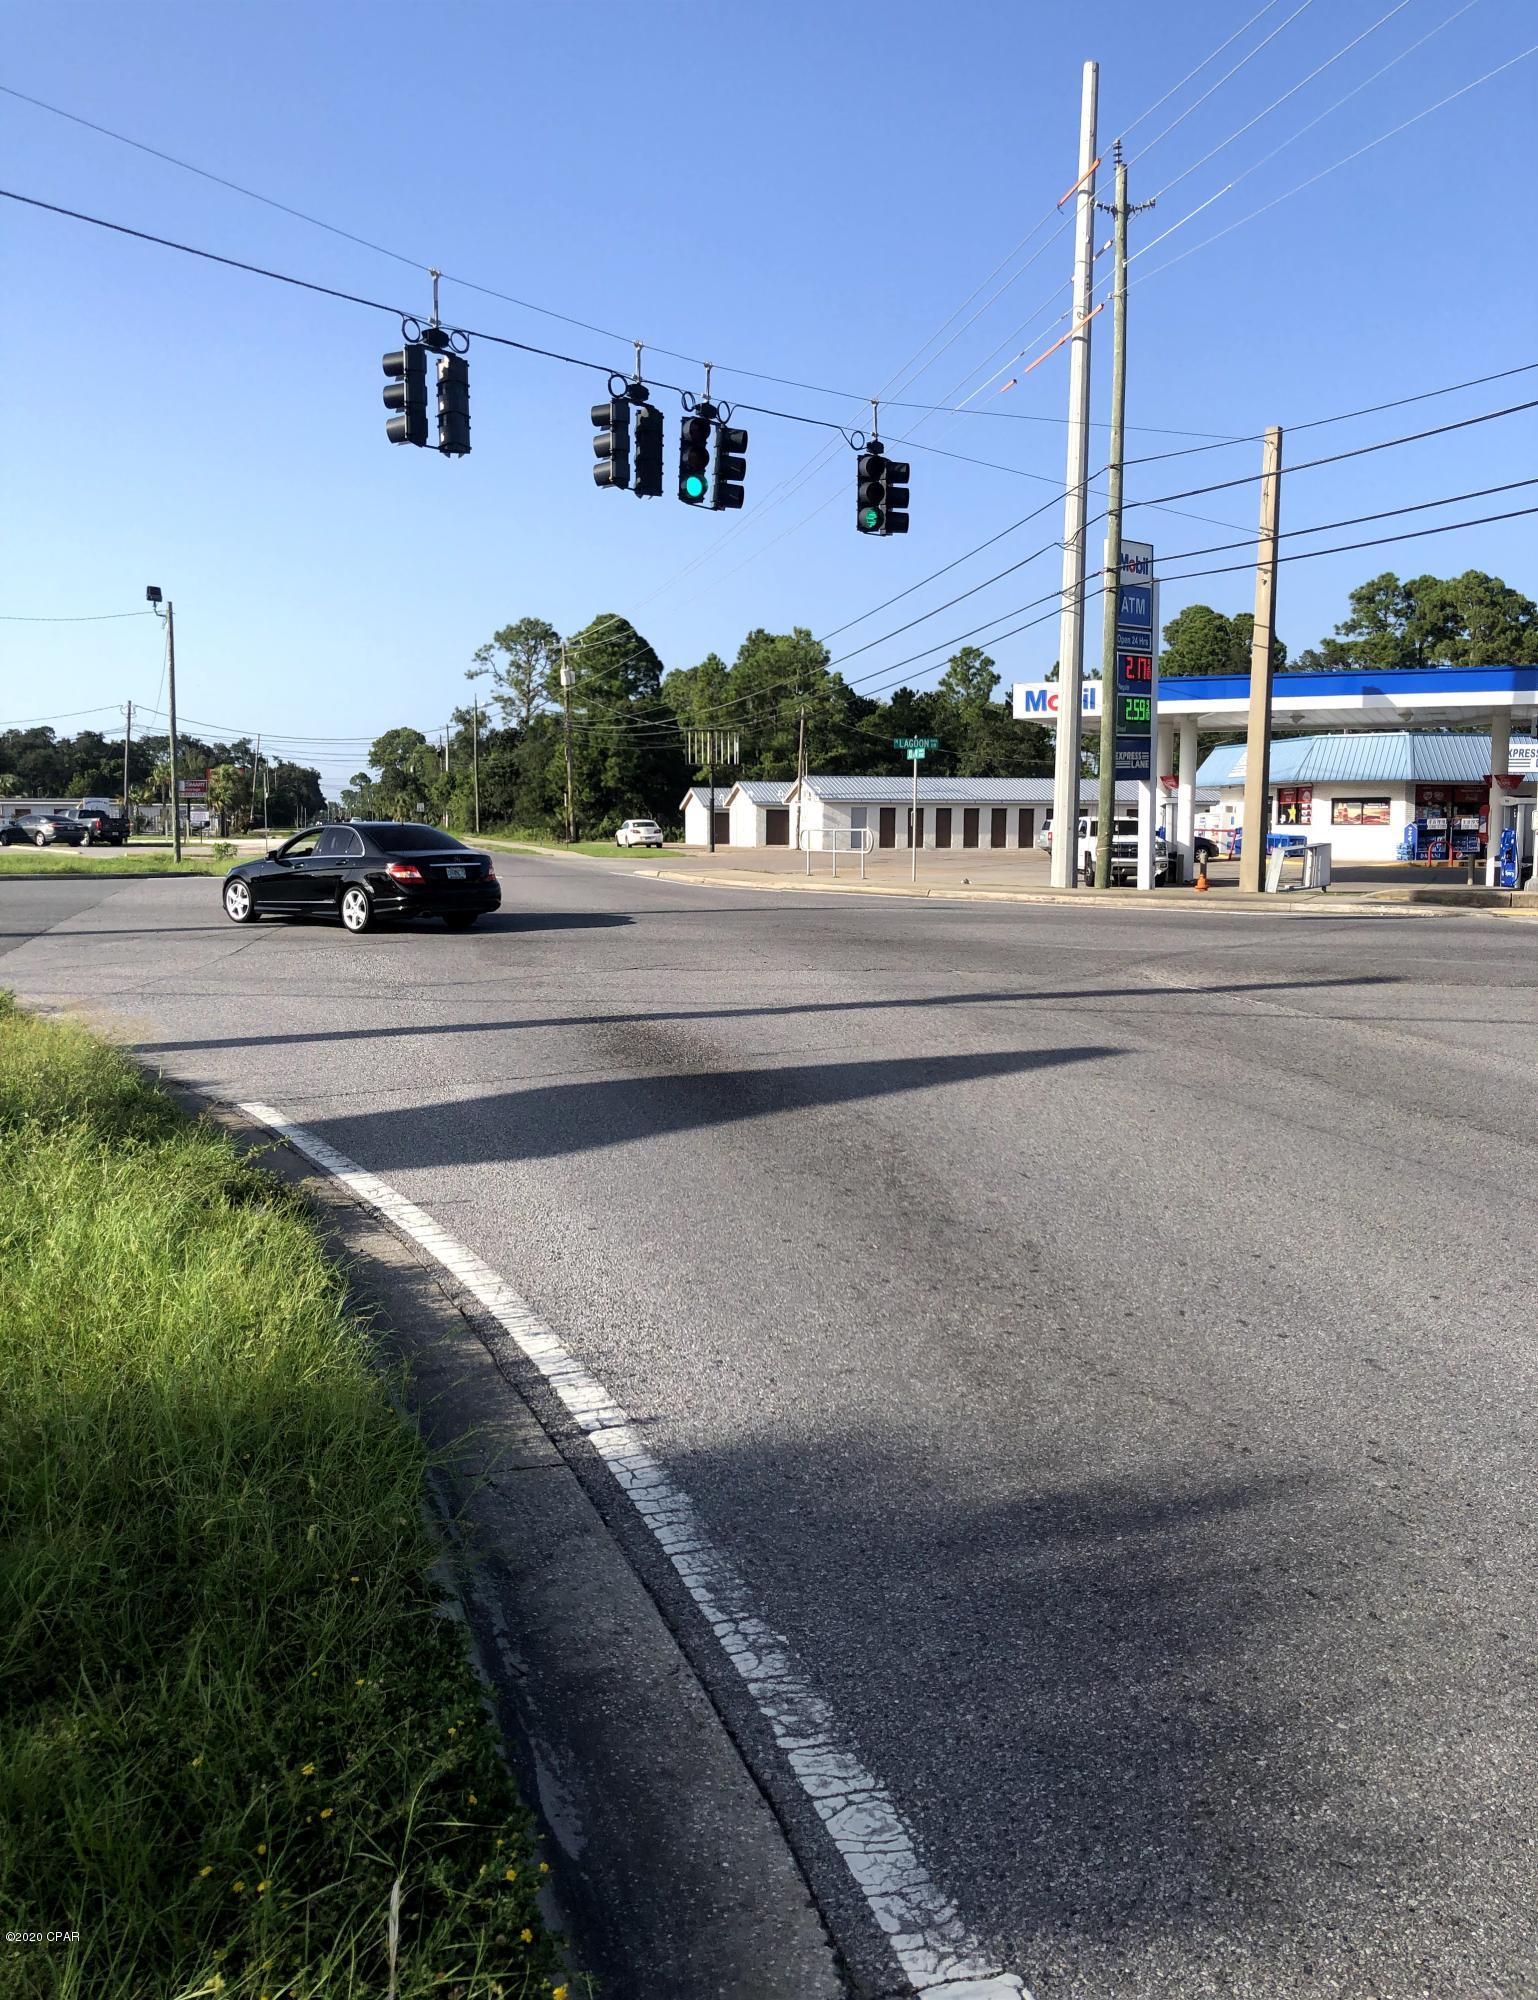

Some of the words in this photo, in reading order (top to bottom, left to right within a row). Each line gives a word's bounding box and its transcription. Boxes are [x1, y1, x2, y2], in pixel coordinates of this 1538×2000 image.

[1120, 553, 1149, 576] Mobil
[1121, 596, 1146, 616] ATM
[1131, 635, 1138, 645] 24
[1025, 687, 1096, 712] Moil
[900, 739, 929, 748] LAGOON
[1131, 760, 1149, 769] LANE
